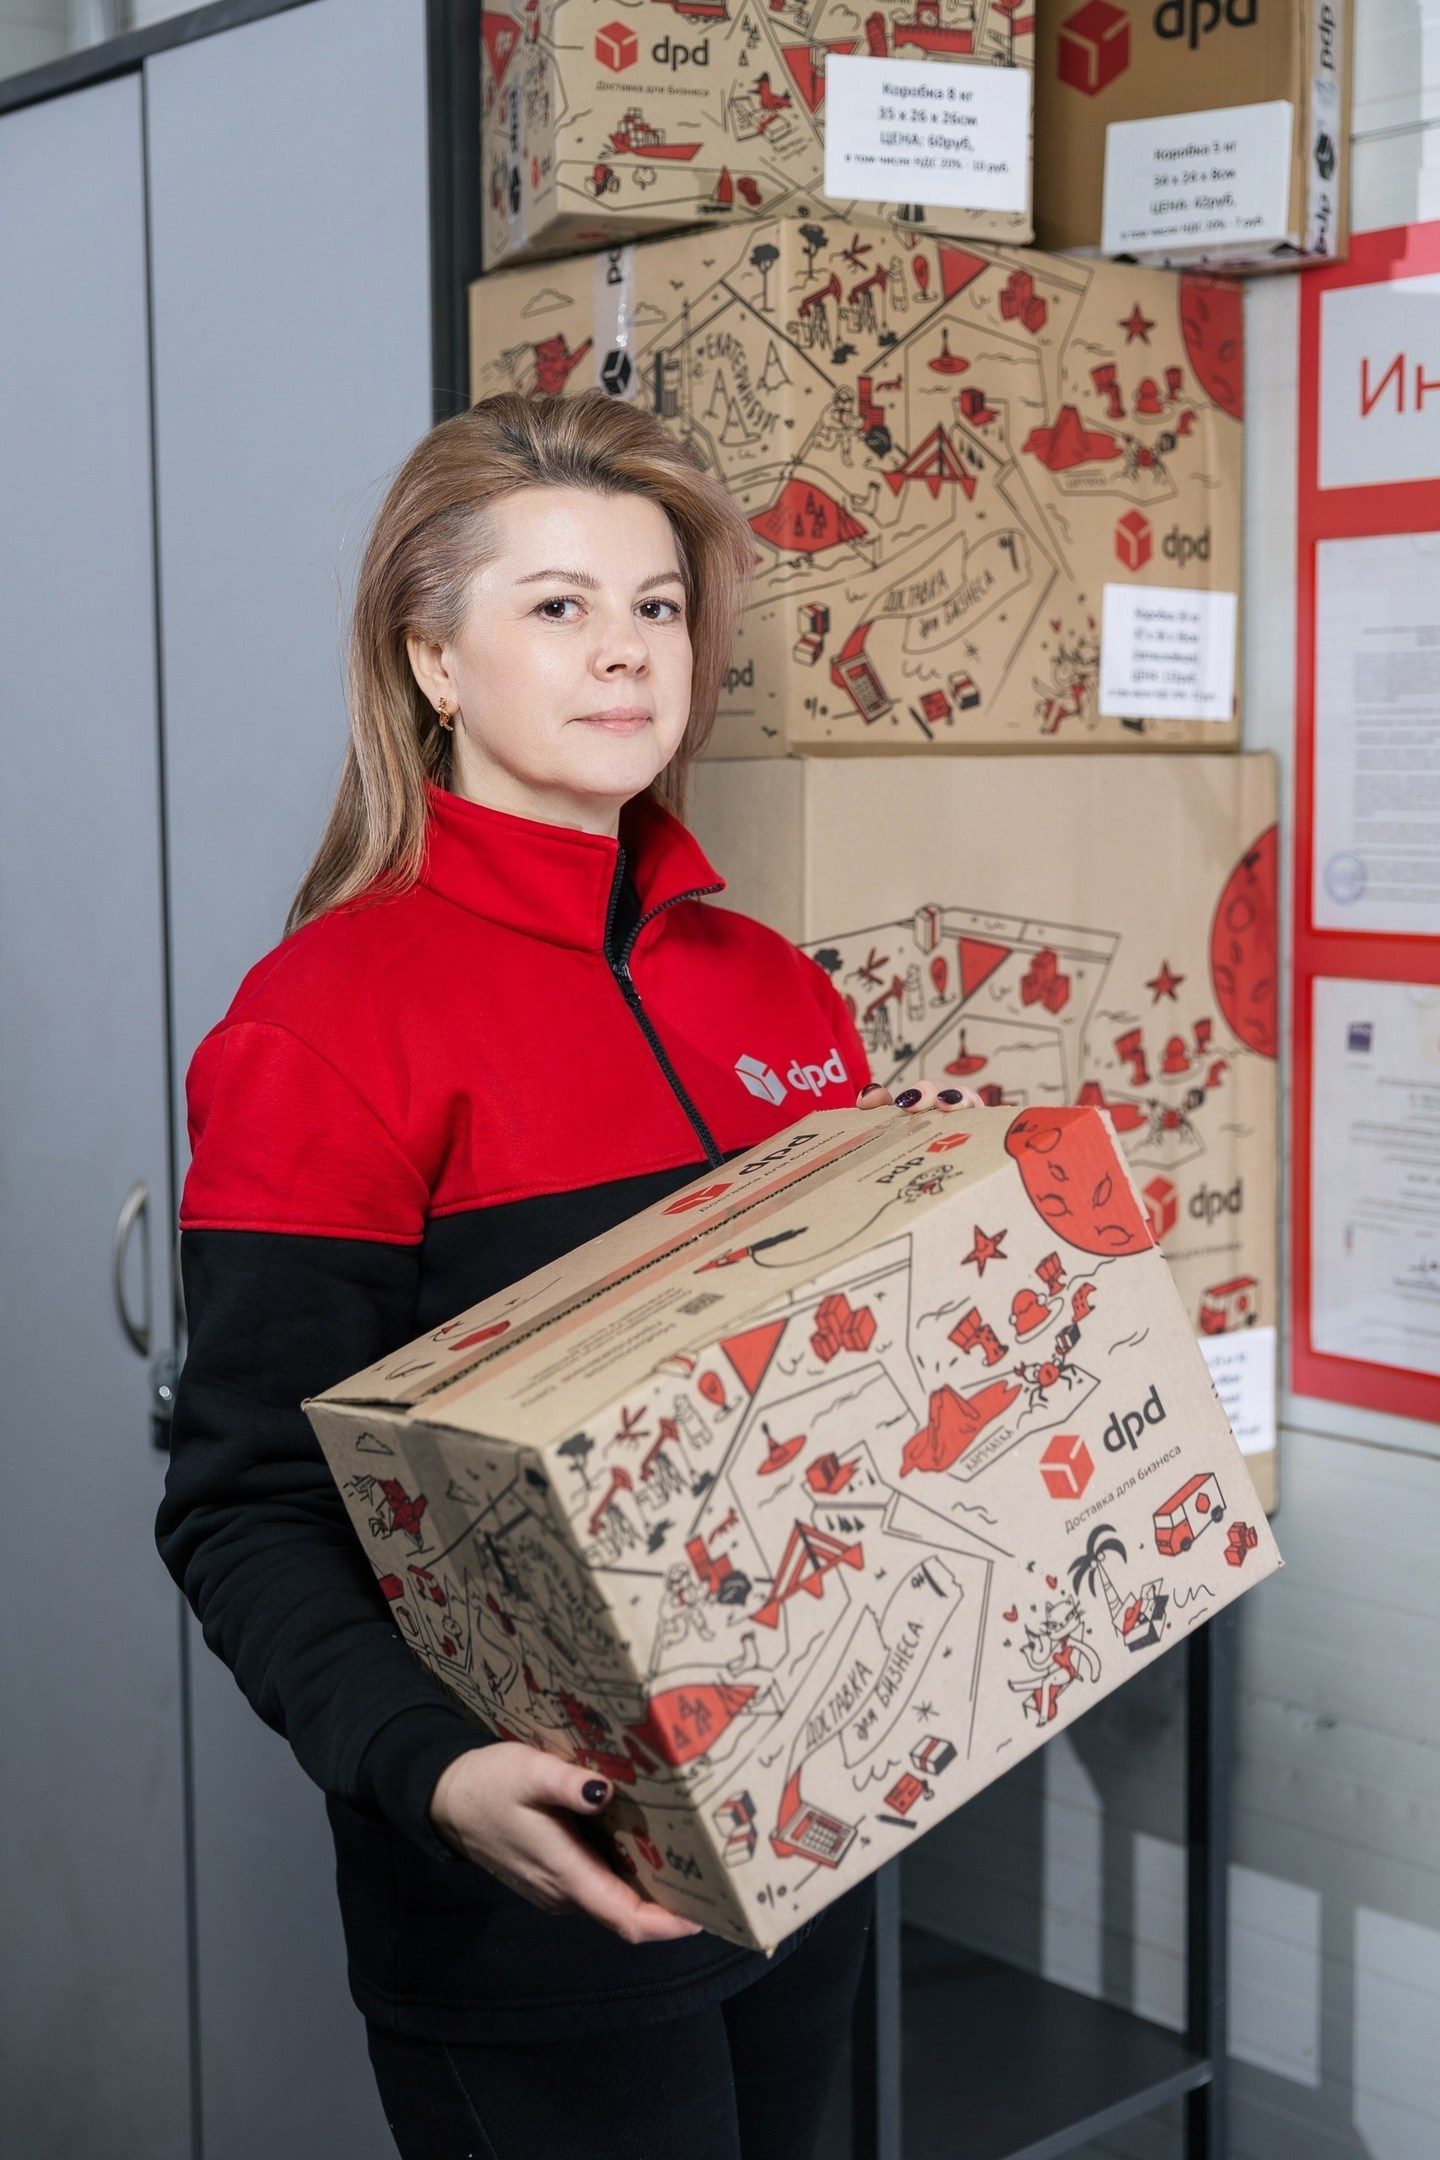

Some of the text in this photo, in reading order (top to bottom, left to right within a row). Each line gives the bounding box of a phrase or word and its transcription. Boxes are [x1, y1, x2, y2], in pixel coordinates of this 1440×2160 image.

[651, 34, 710, 72] dpd
[881, 82, 975, 102] Коробка 8 кг
[878, 106, 896, 120] 35
[910, 108, 928, 123] 26
[941, 110, 978, 127] 26см
[1153, 142, 1211, 163] Коробка
[1161, 523, 1211, 568] dpd
[721, 658, 755, 696] pd
[786, 1047, 848, 1097] dpd
[1188, 1176, 1243, 1226] dpd
[1102, 1384, 1167, 1453] dpd
[965, 1427, 1017, 1473] КАМЧАТКА
[1063, 1443, 1183, 1536] Доставка для бизнеса
[851, 1619, 925, 1742] для БИЗНЕСА
[805, 1659, 875, 1751] ДОСТАВКА
